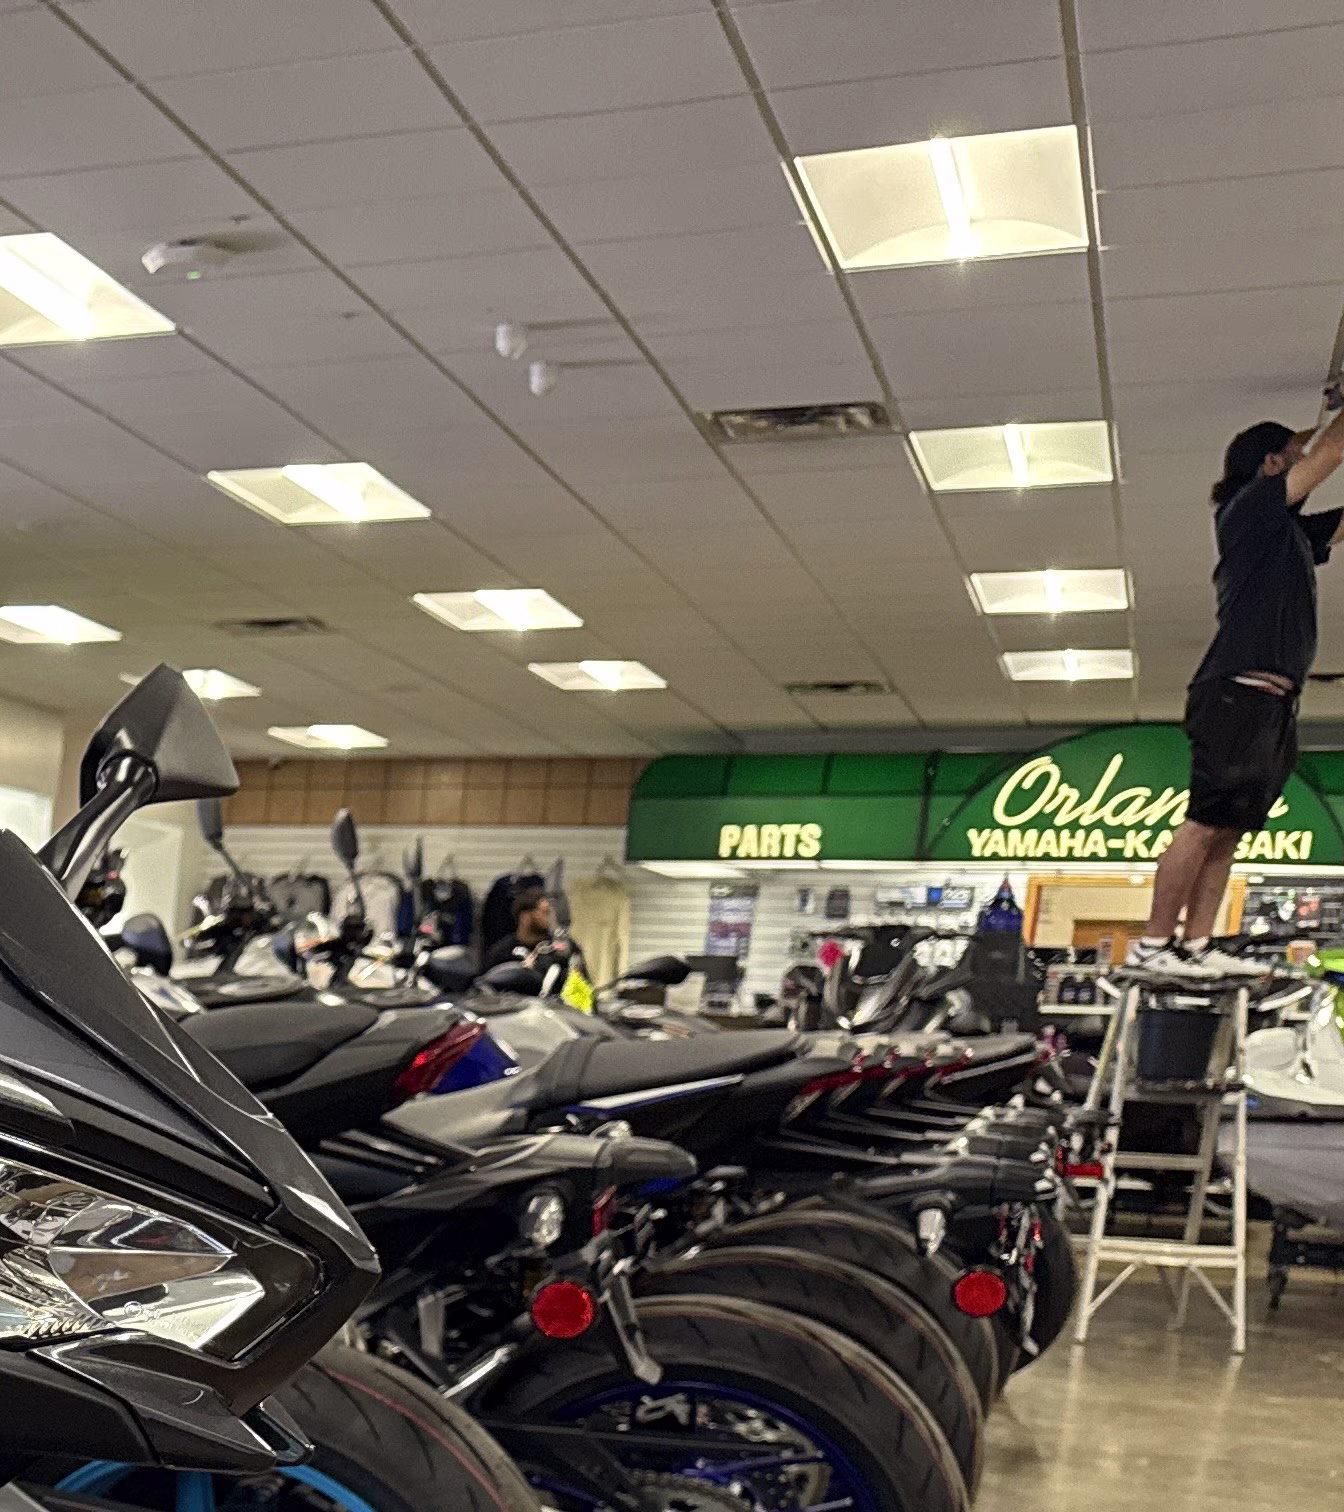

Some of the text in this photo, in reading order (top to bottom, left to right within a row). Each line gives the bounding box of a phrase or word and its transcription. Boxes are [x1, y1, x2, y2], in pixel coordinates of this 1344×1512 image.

[992, 752, 1289, 827] Orlan
[718, 823, 823, 858] PARTS
[966, 827, 1313, 860] YAMAHA-KASAKI
